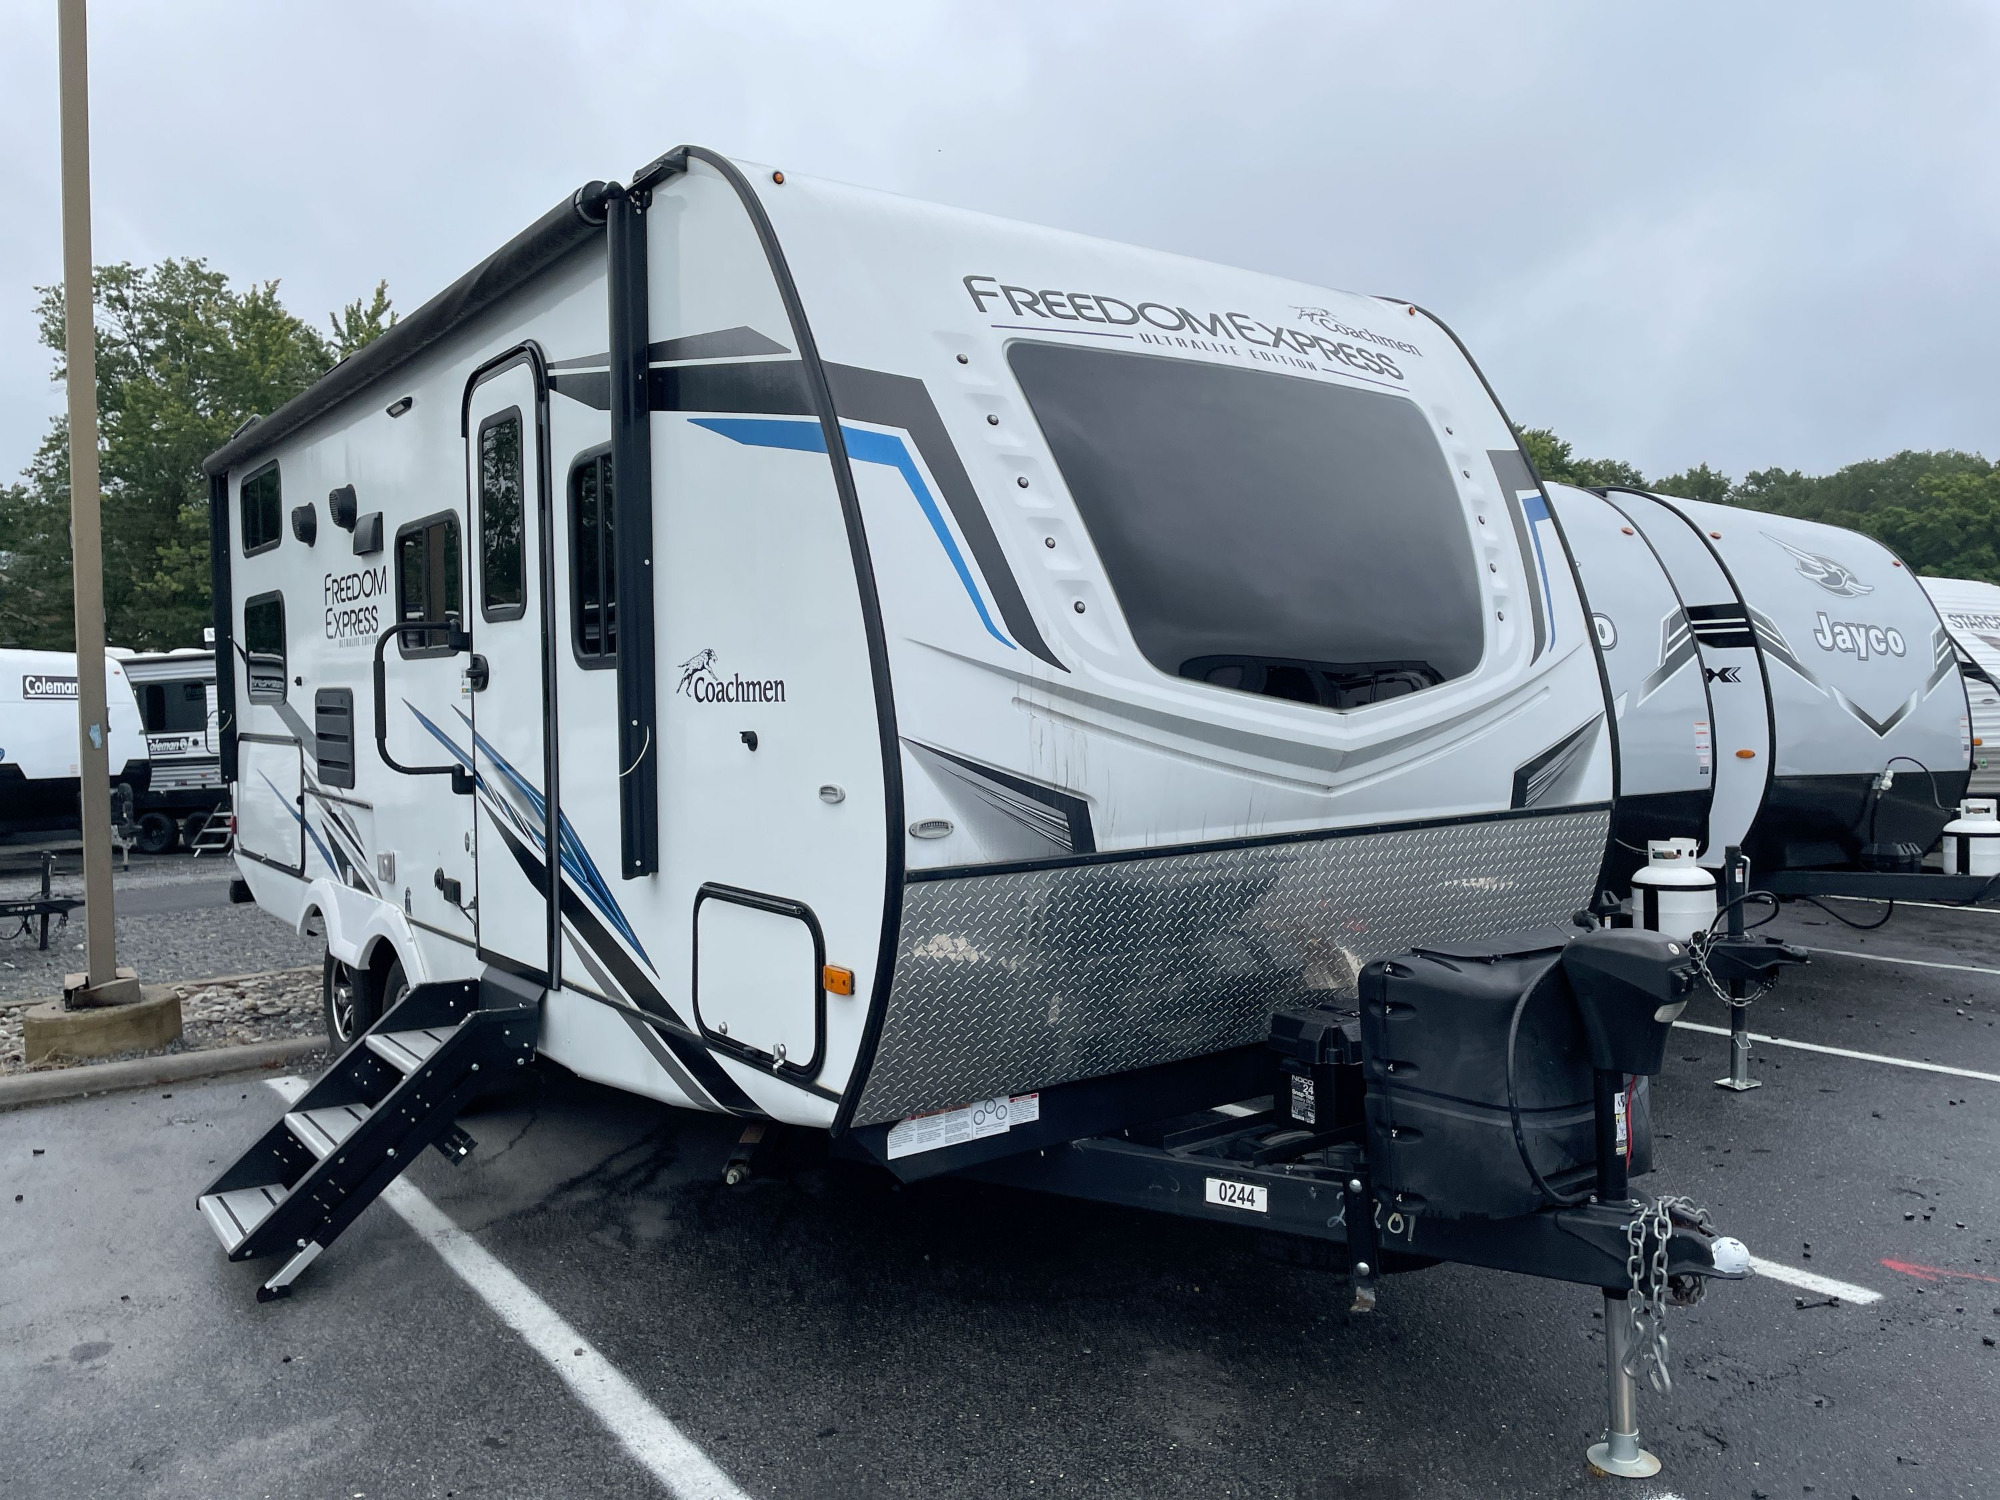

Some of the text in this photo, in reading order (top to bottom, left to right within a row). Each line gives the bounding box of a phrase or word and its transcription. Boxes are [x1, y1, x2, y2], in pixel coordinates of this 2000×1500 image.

[1138, 333, 1318, 372] ULTRALITE EDITION
[1318, 318, 1423, 357] Coachmen
[324, 565, 387, 606] FREEDOM
[325, 605, 379, 639] EXPRESS
[1813, 611, 1906, 661] Jayco
[25, 676, 78, 694] Coleman
[694, 673, 786, 703] Coachmen
[1303, 1084, 1314, 1096] 24
[1219, 1182, 1255, 1207] 0244
